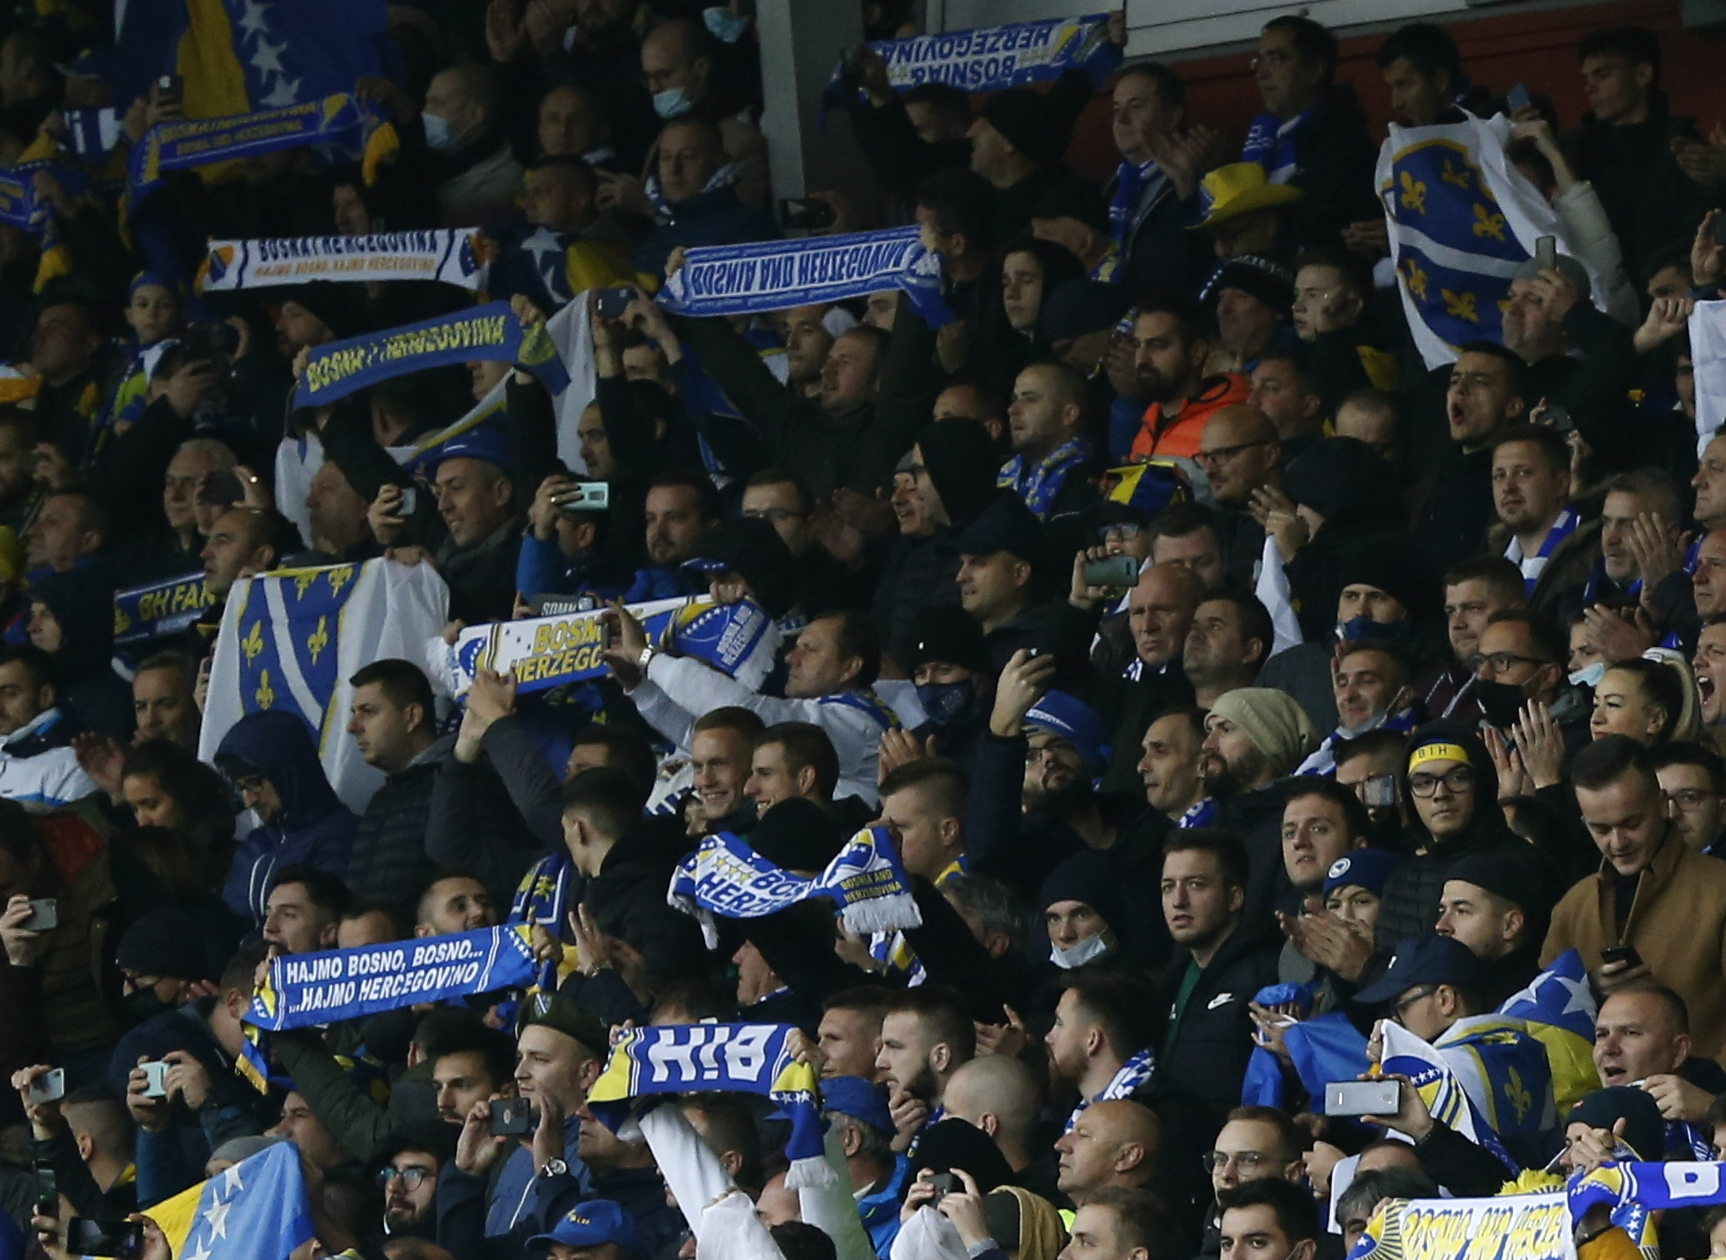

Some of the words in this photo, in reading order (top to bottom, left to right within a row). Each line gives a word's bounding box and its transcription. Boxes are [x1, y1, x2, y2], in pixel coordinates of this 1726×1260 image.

[286, 956, 343, 986] HAJMO
[347, 949, 408, 979] BOSNO,
[357, 960, 480, 1004] HERCEGOVINO
